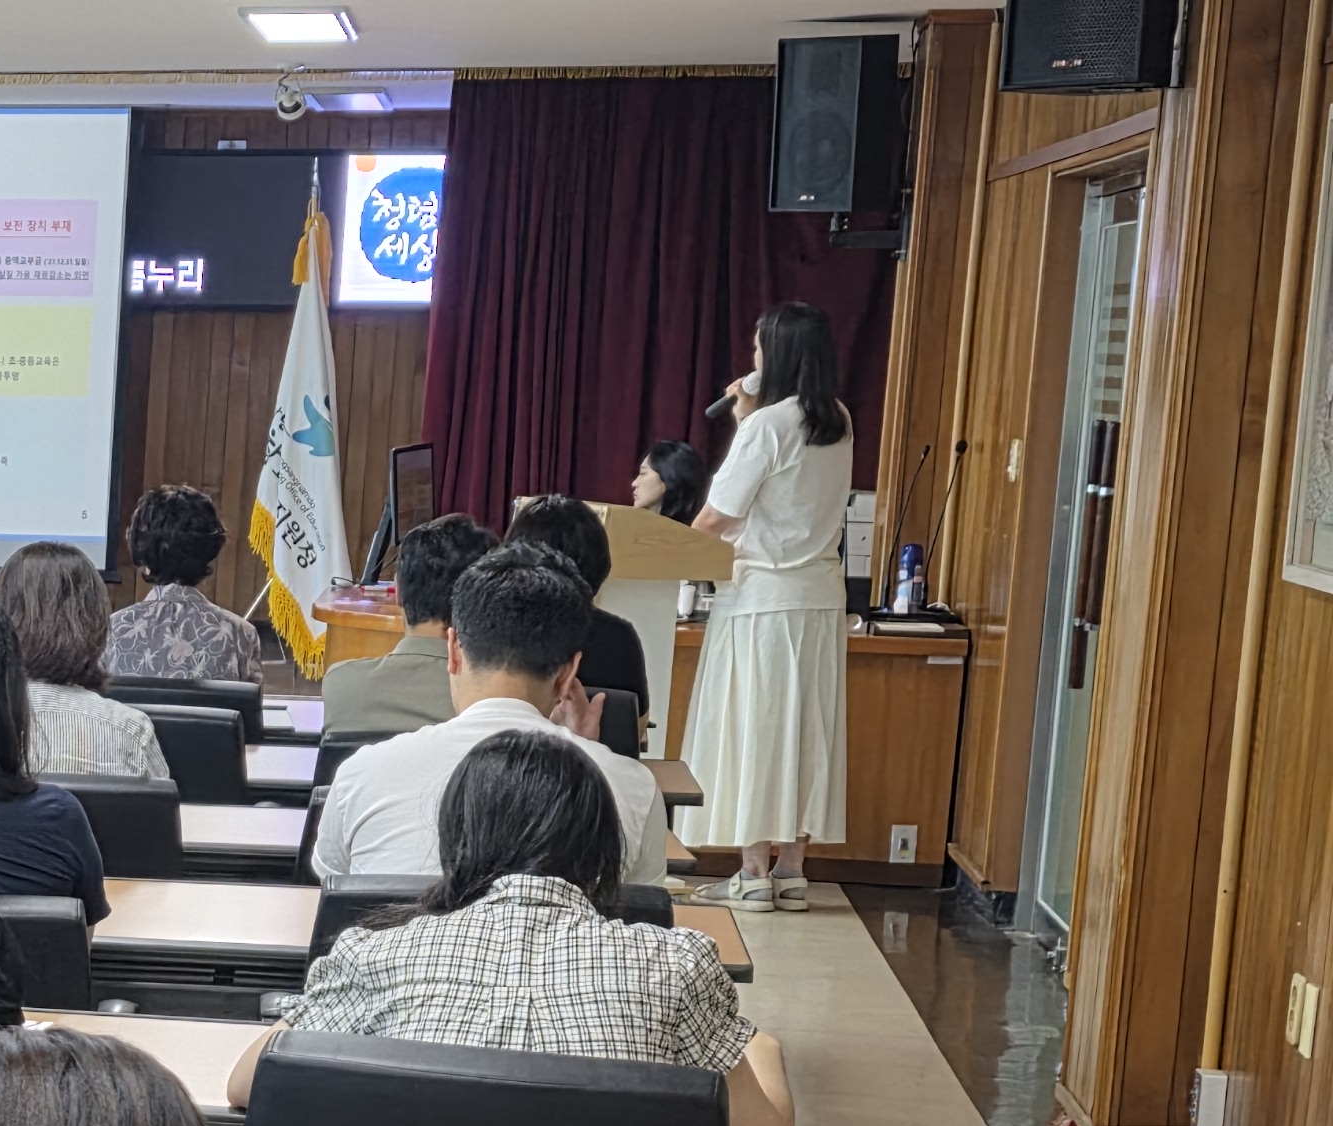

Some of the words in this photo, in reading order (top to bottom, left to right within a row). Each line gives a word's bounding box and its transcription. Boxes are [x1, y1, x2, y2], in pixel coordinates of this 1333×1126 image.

[3, 220, 23, 232] 보전
[28, 220, 46, 232] 장치
[51, 220, 72, 232] 부재
[82, 510, 88, 520] 5
